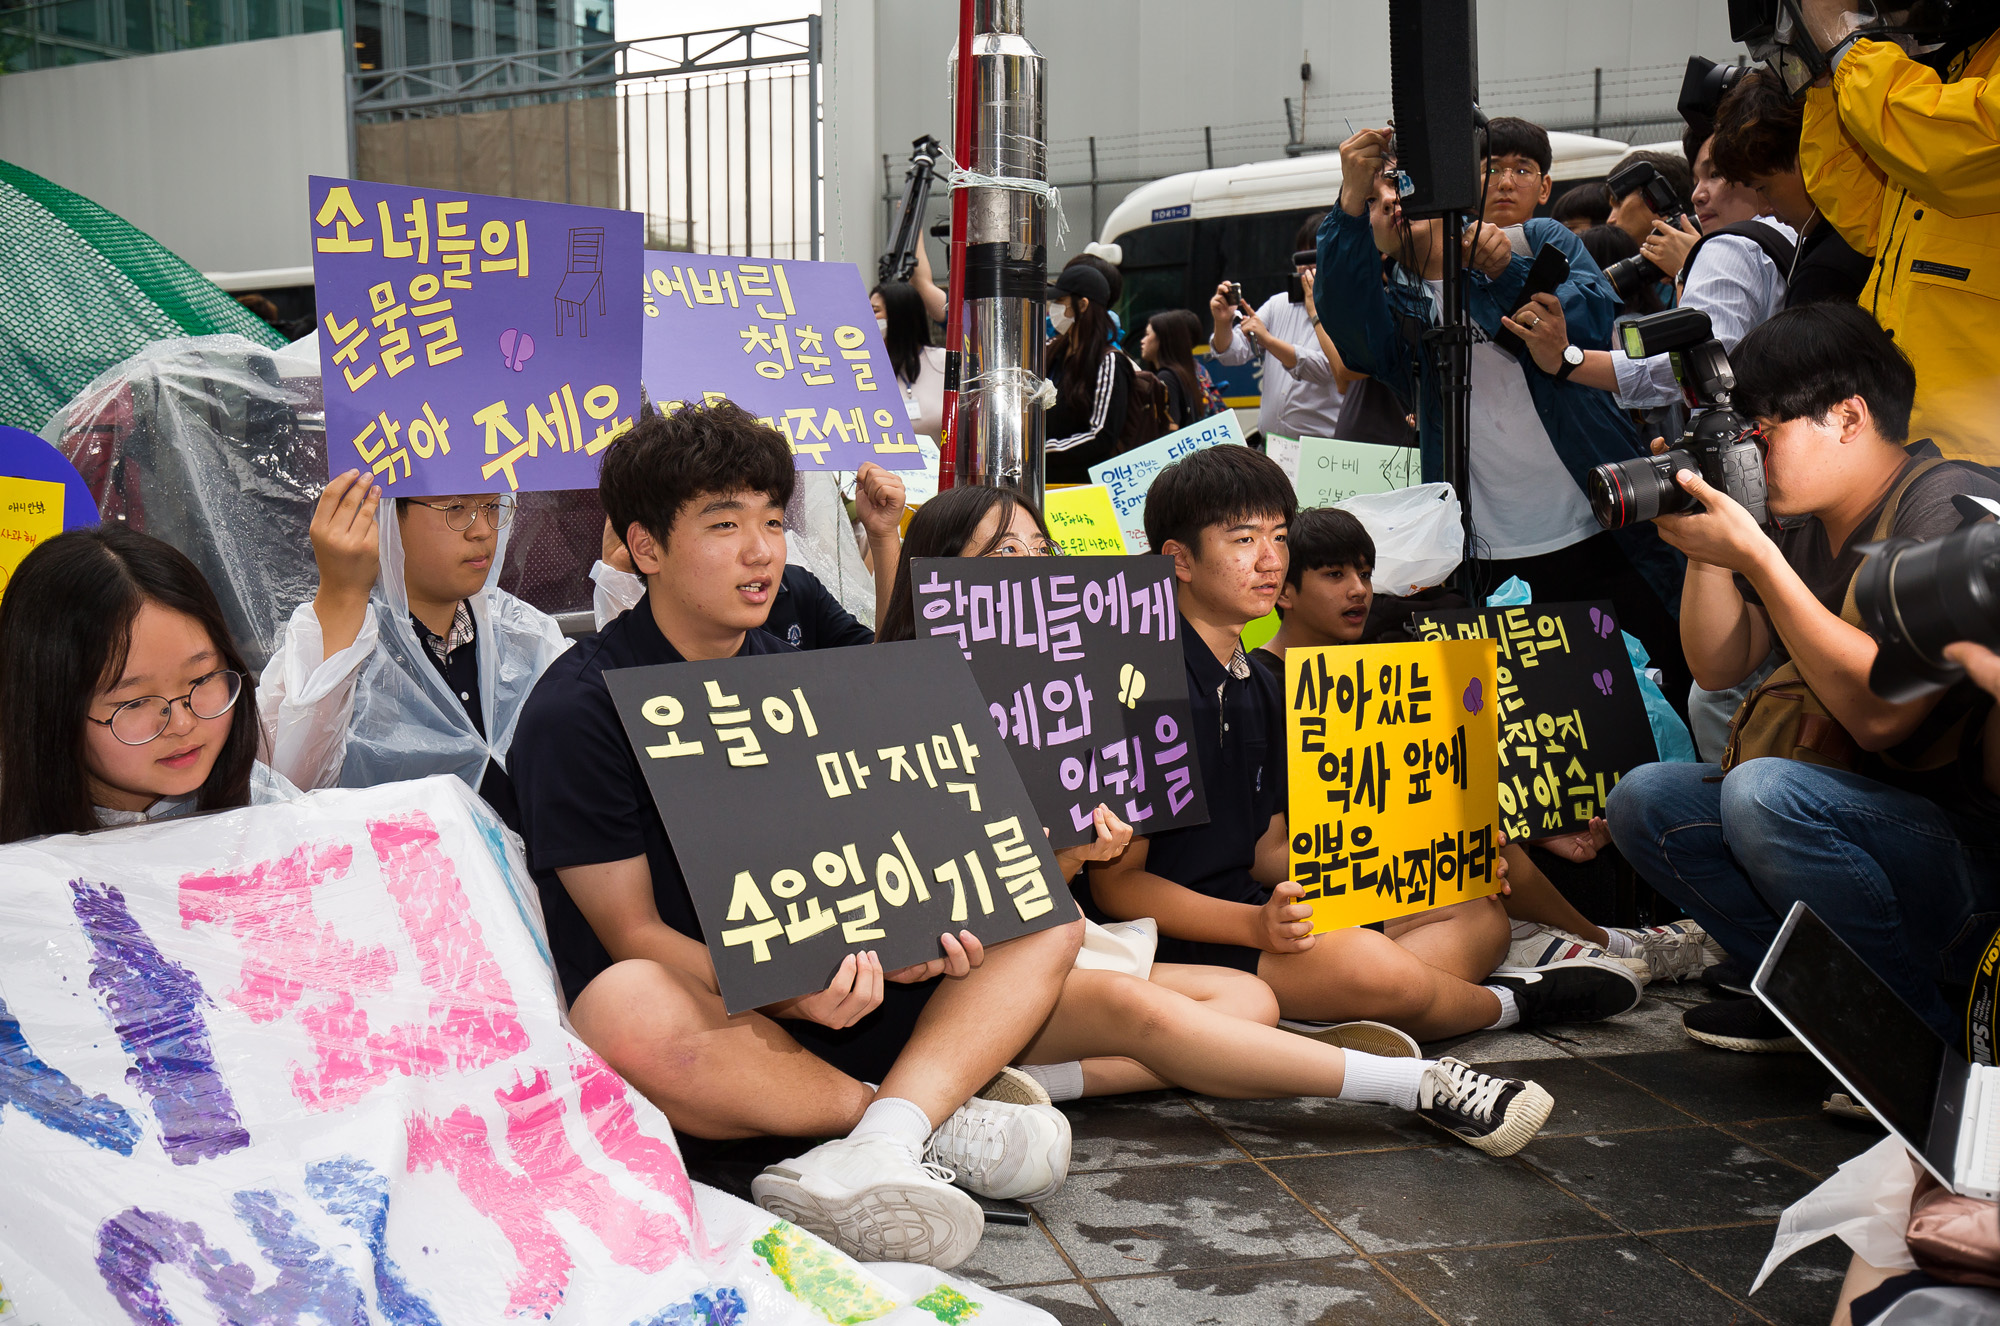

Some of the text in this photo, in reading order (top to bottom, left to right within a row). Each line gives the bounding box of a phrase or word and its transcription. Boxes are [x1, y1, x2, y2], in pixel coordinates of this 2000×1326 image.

[315, 185, 530, 290] 소녀들의
[324, 280, 464, 393] 눈물을
[739, 324, 878, 392] 청춘을
[352, 383, 633, 491] 닦아 주세요
[1317, 455, 1359, 475] 아베
[918, 571, 1177, 661] 할머니들에게
[641, 680, 819, 768] 오늘이
[816, 723, 981, 812] 마지막
[1058, 714, 1194, 832] 인권을
[1317, 725, 1468, 814] 역사 앞에
[721, 816, 1055, 965] 수요일이기를
[1973, 1021, 1992, 1066] NPS
